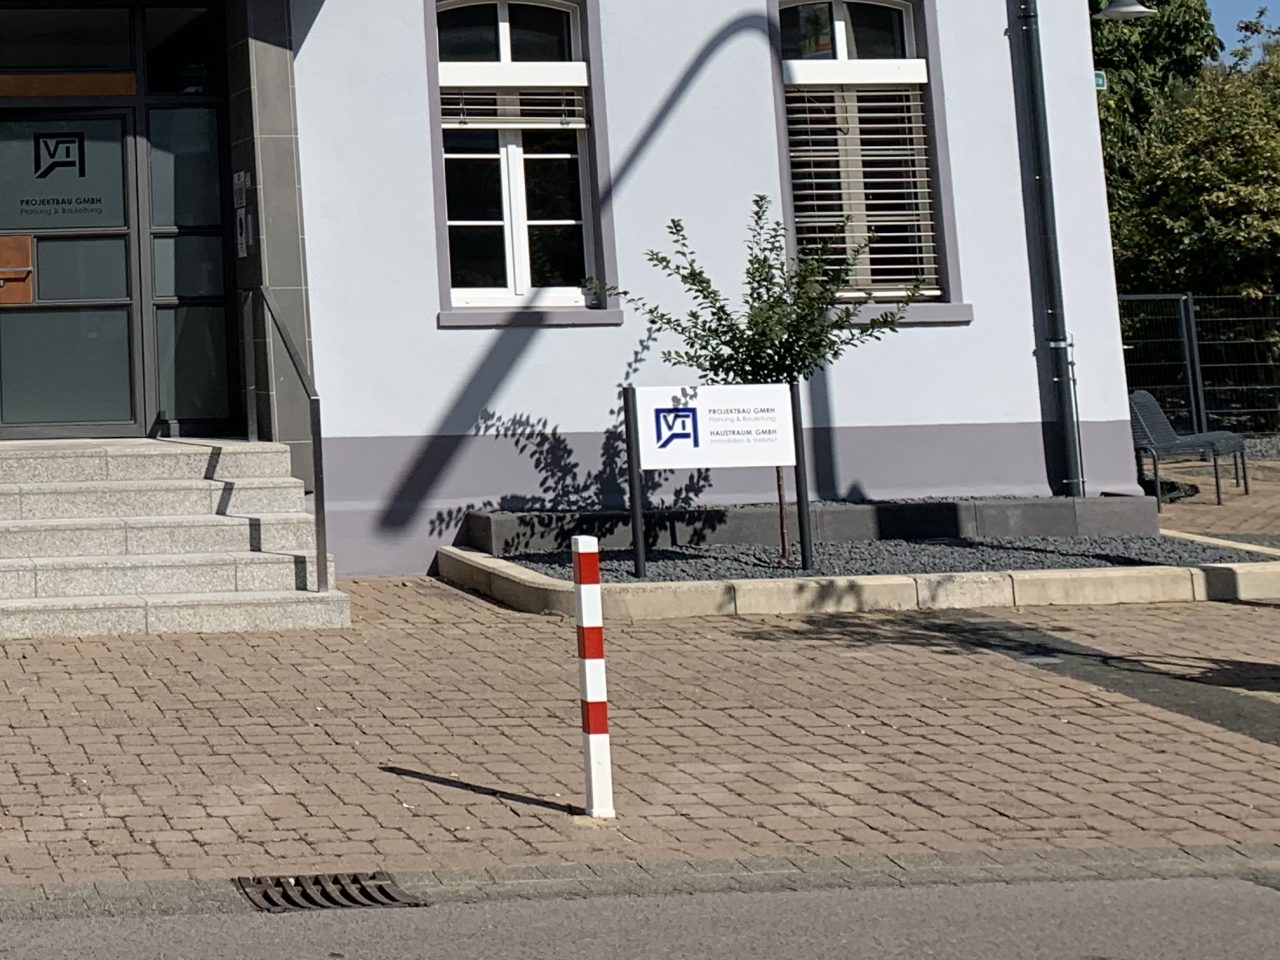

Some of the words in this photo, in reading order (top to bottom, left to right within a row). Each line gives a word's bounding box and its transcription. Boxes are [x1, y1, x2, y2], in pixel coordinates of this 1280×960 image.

[20, 198, 73, 206] PROJEKTBAU
[75, 197, 102, 205] GMBH
[710, 429, 752, 437] HAUSTRAUM
[755, 428, 777, 436] GMBH
